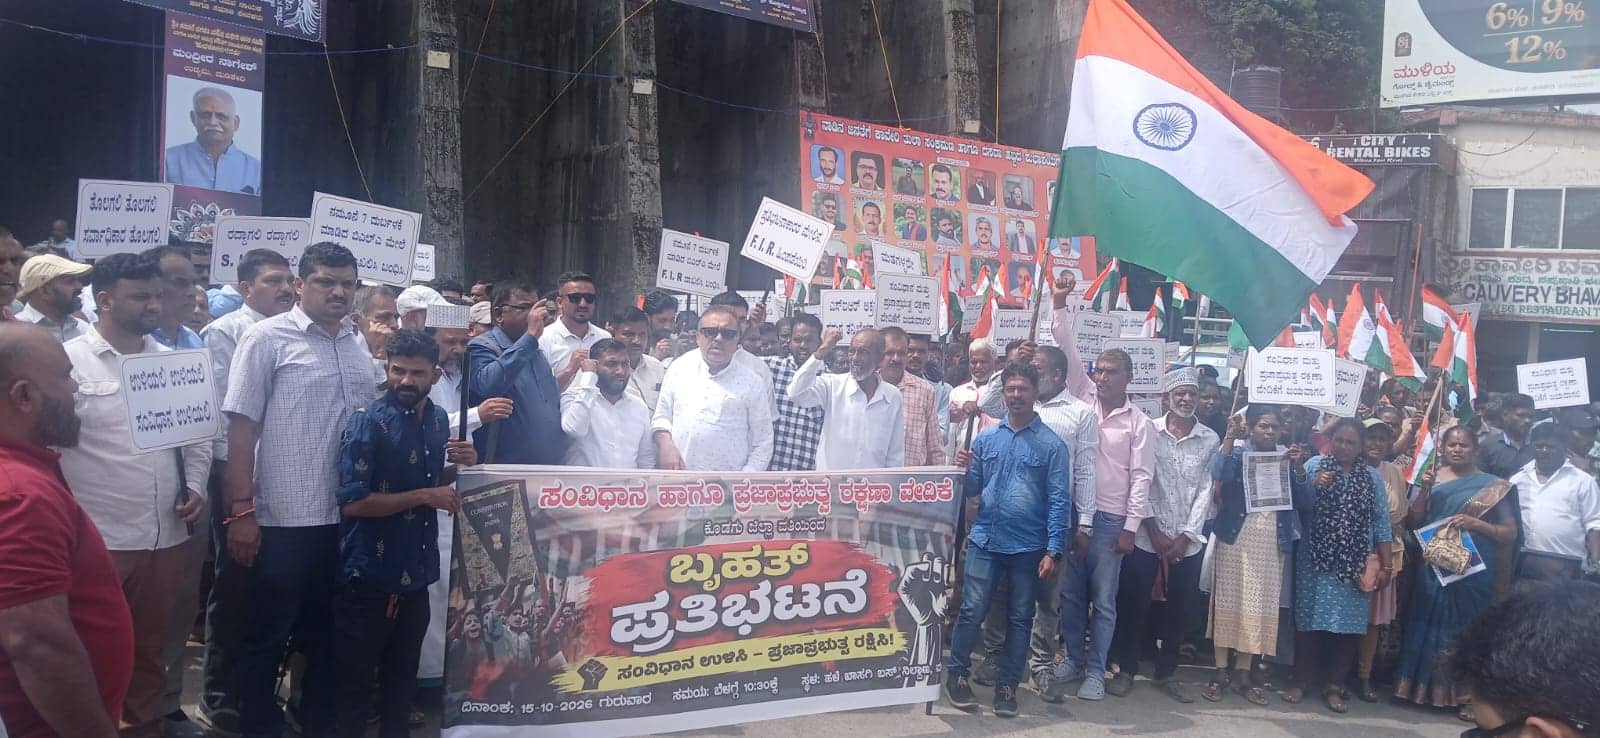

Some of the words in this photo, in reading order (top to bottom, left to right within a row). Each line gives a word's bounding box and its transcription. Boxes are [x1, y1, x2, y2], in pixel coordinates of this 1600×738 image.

[1486, 2, 1529, 30] 6%
[1541, 0, 1586, 29] 9%
[1505, 35, 1567, 64] 12%
[1393, 61, 1456, 79] ಮುಳಿಯ
[821, 120, 844, 133] ನಾಡಿನ
[848, 123, 872, 139] ಜನತೆಗೆ
[875, 128, 900, 143] ಕಾವೇರಿ
[1360, 135, 1396, 147] CITY
[1326, 147, 1380, 159] RENTAL
[1384, 147, 1431, 158] BIKES
[89, 192, 122, 213] ತೊಲಗಲಿ
[125, 194, 157, 213] ತೊಲಗಲಿ
[1463, 283, 1552, 303] CAUVERY
[1556, 286, 1600, 305] BHAV
[538, 479, 649, 512] ಸಂವಿಧಾನ
[657, 479, 725, 508] ಹಾಗೂ
[732, 478, 832, 515] ಪ್ರಜಾಪ್ರಭುತ್ವ
[838, 478, 893, 512] ರಕ್ಷಣಾ
[899, 477, 954, 502] ವೇದಿಕೆ
[704, 519, 743, 536] ಕೊಡಗು
[748, 519, 775, 540] ಜಿಲ್ಲಾ
[778, 518, 827, 534] ವತಿಯಿಂದ
[669, 543, 809, 591] ಬೃಹತ್
[610, 568, 868, 653] ಪ್ರತಿಭಟನೆ
[617, 655, 695, 681] ಸಂವಿಧಾನ
[700, 650, 748, 669] ಉಳಿಸಿ
[768, 634, 850, 662] ಪ್ರಜಾಪ್ರಭುತ್ವ
[854, 632, 894, 652] ರಕ್ಷಿಸಿ!
[461, 700, 514, 714] ದಿನಾಂಕ:
[521, 699, 593, 713] 15-10-2026
[599, 692, 652, 708] ಗುರುವಾರ
[672, 684, 710, 701] ಸಮಯ:
[714, 682, 740, 699] ಬೆಳಗ್ಗೆ
[824, 670, 841, 684] ಹಳೆ
[877, 664, 899, 679] ಬಸ್
